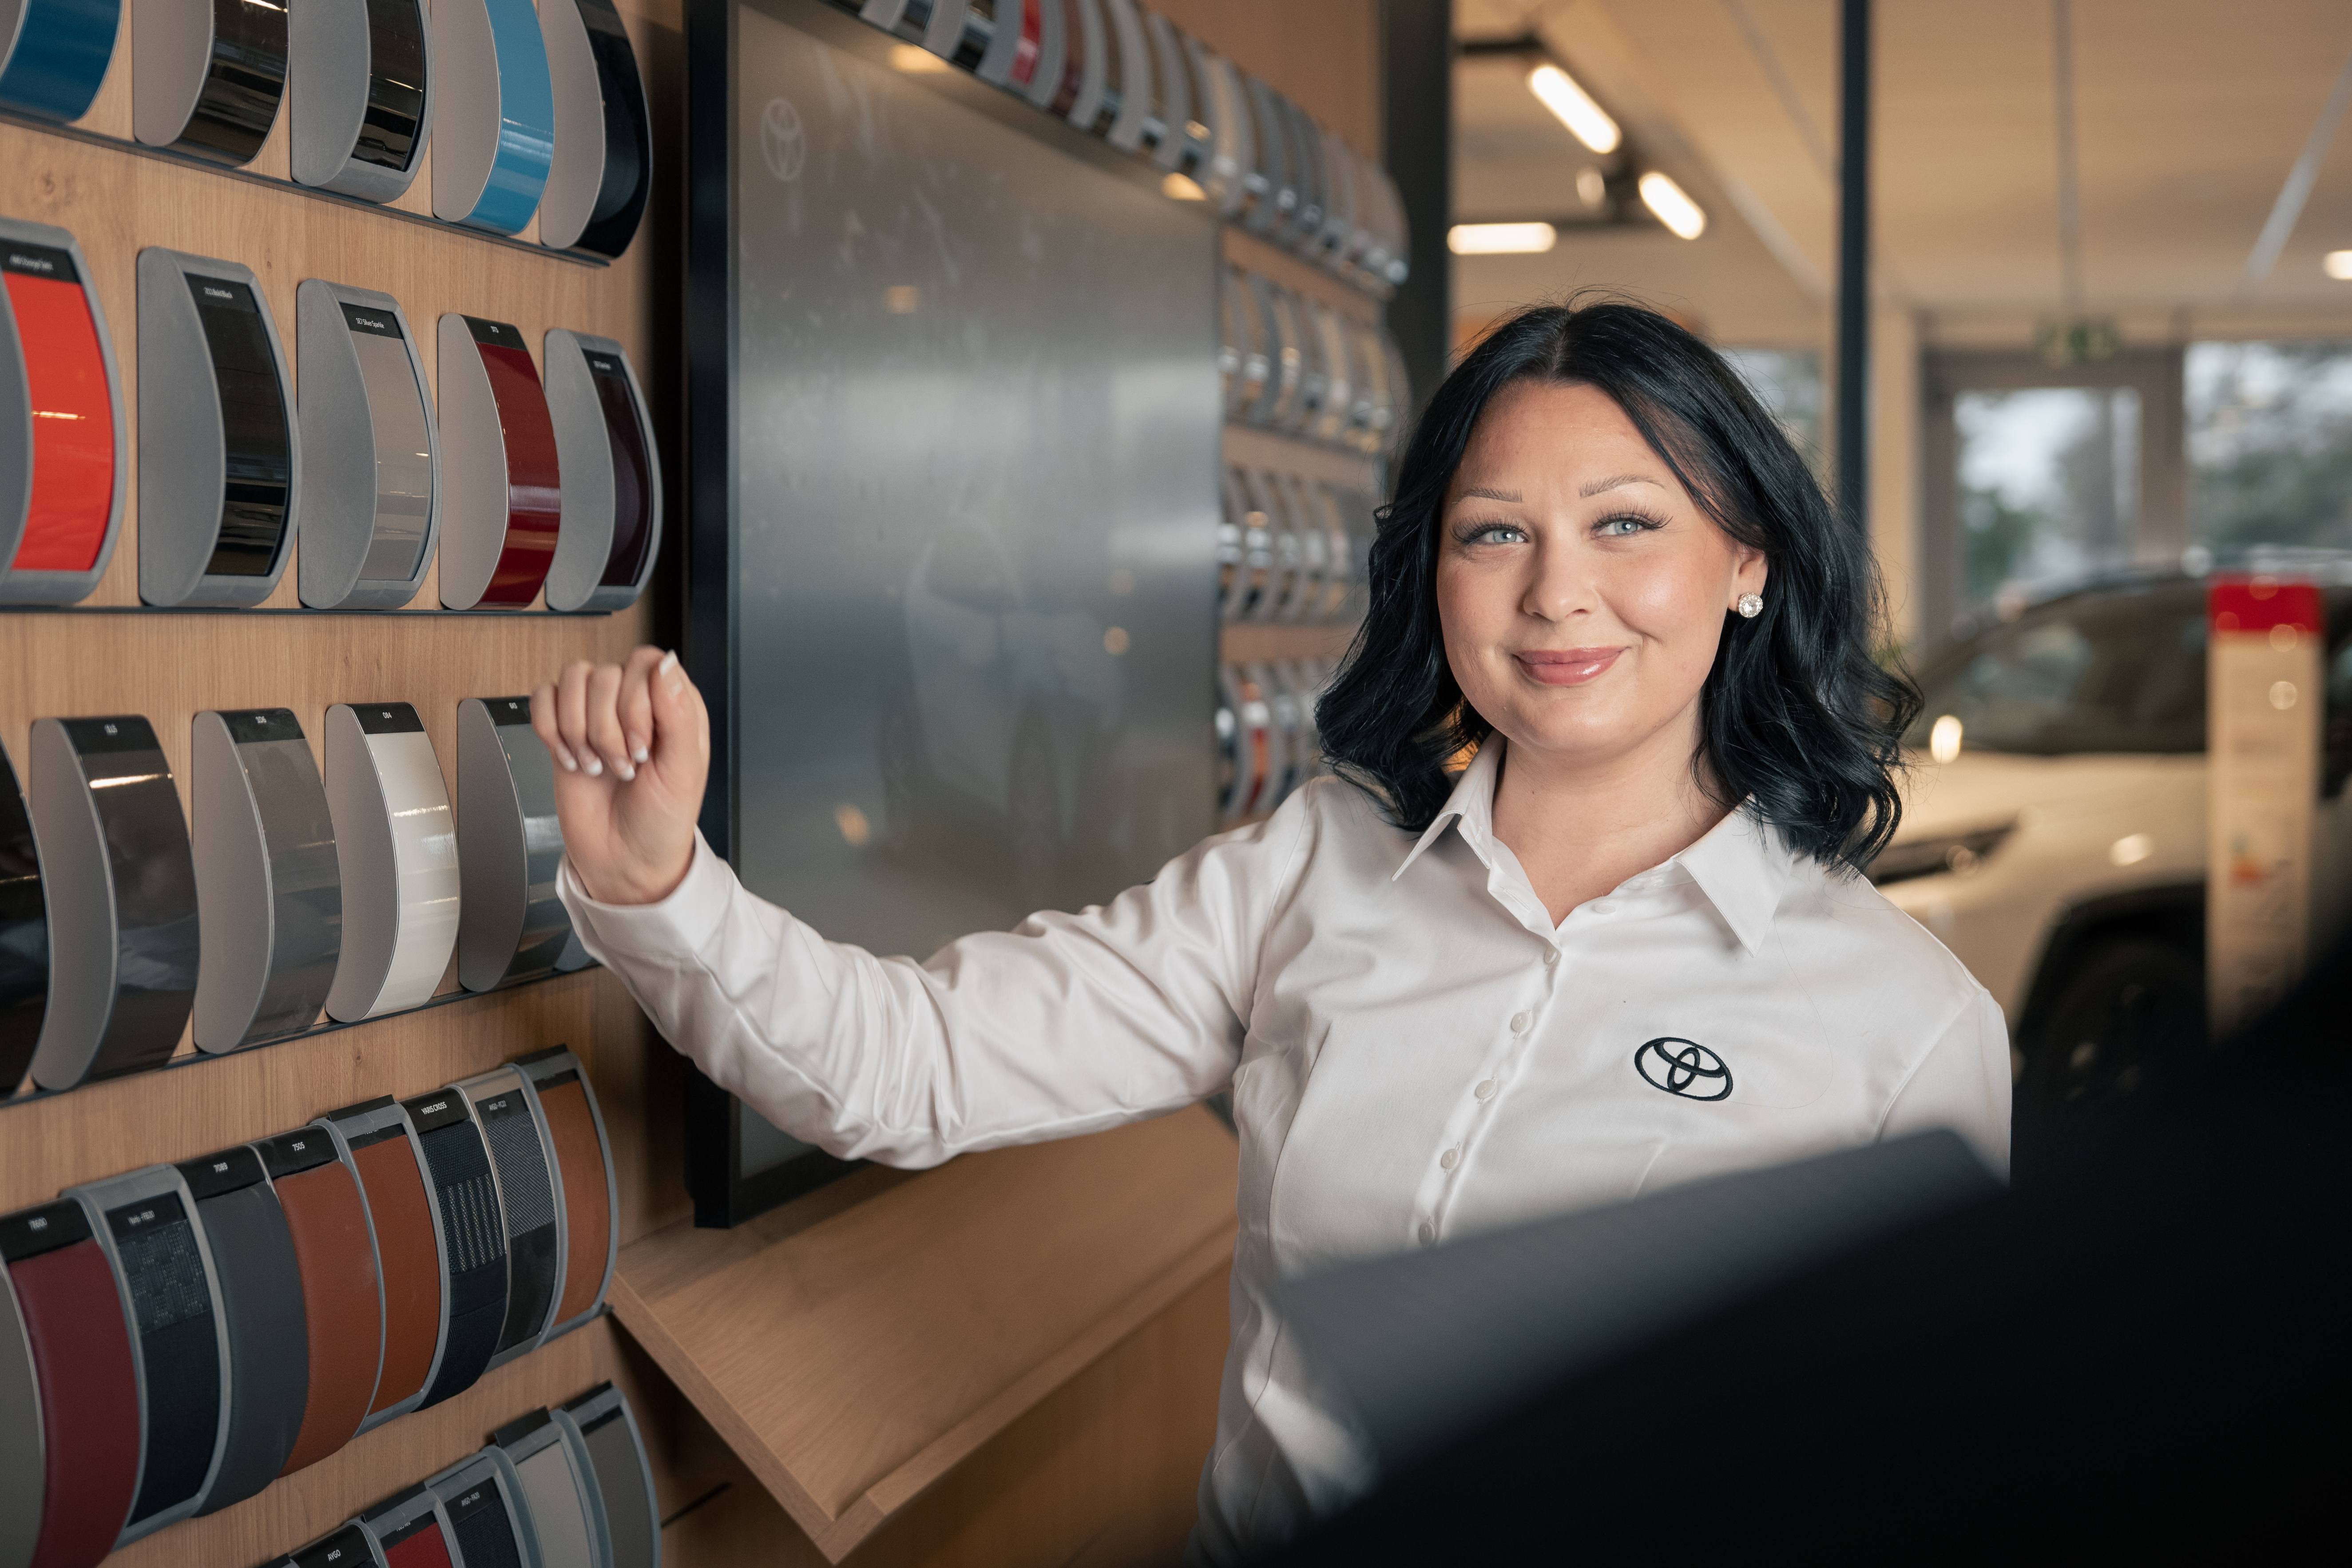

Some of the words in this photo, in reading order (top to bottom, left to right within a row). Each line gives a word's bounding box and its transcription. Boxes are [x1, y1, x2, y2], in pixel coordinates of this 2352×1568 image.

[421, 1106, 434, 1115] YARIS
[433, 1101, 447, 1111] CROSS
[292, 1141, 305, 1151] 7505
[327, 1549, 341, 1561] AYGO
